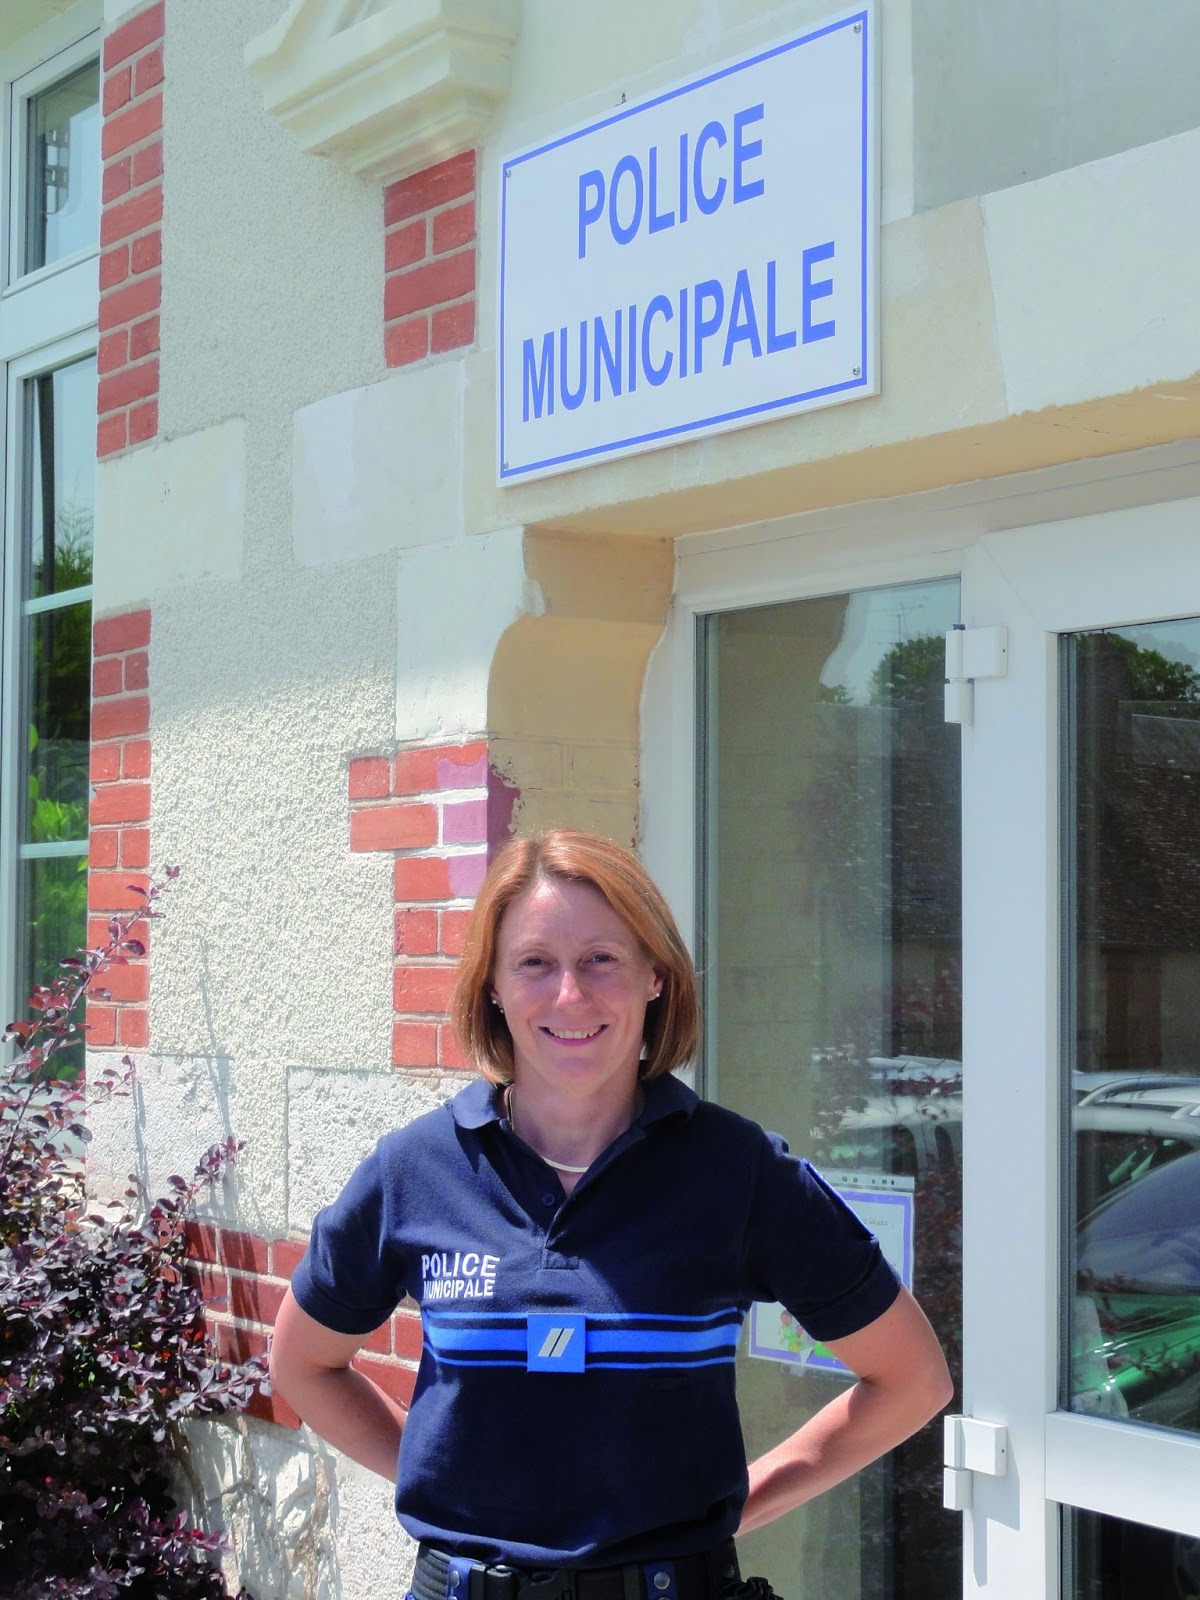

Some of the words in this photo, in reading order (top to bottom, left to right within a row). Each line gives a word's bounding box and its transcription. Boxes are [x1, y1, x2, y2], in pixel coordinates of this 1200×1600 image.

[578, 102, 765, 260] POLICE
[522, 240, 836, 423] MUNICIPALE
[421, 1252, 501, 1279] POLICE
[423, 1279, 496, 1300] MUNICIPALE
